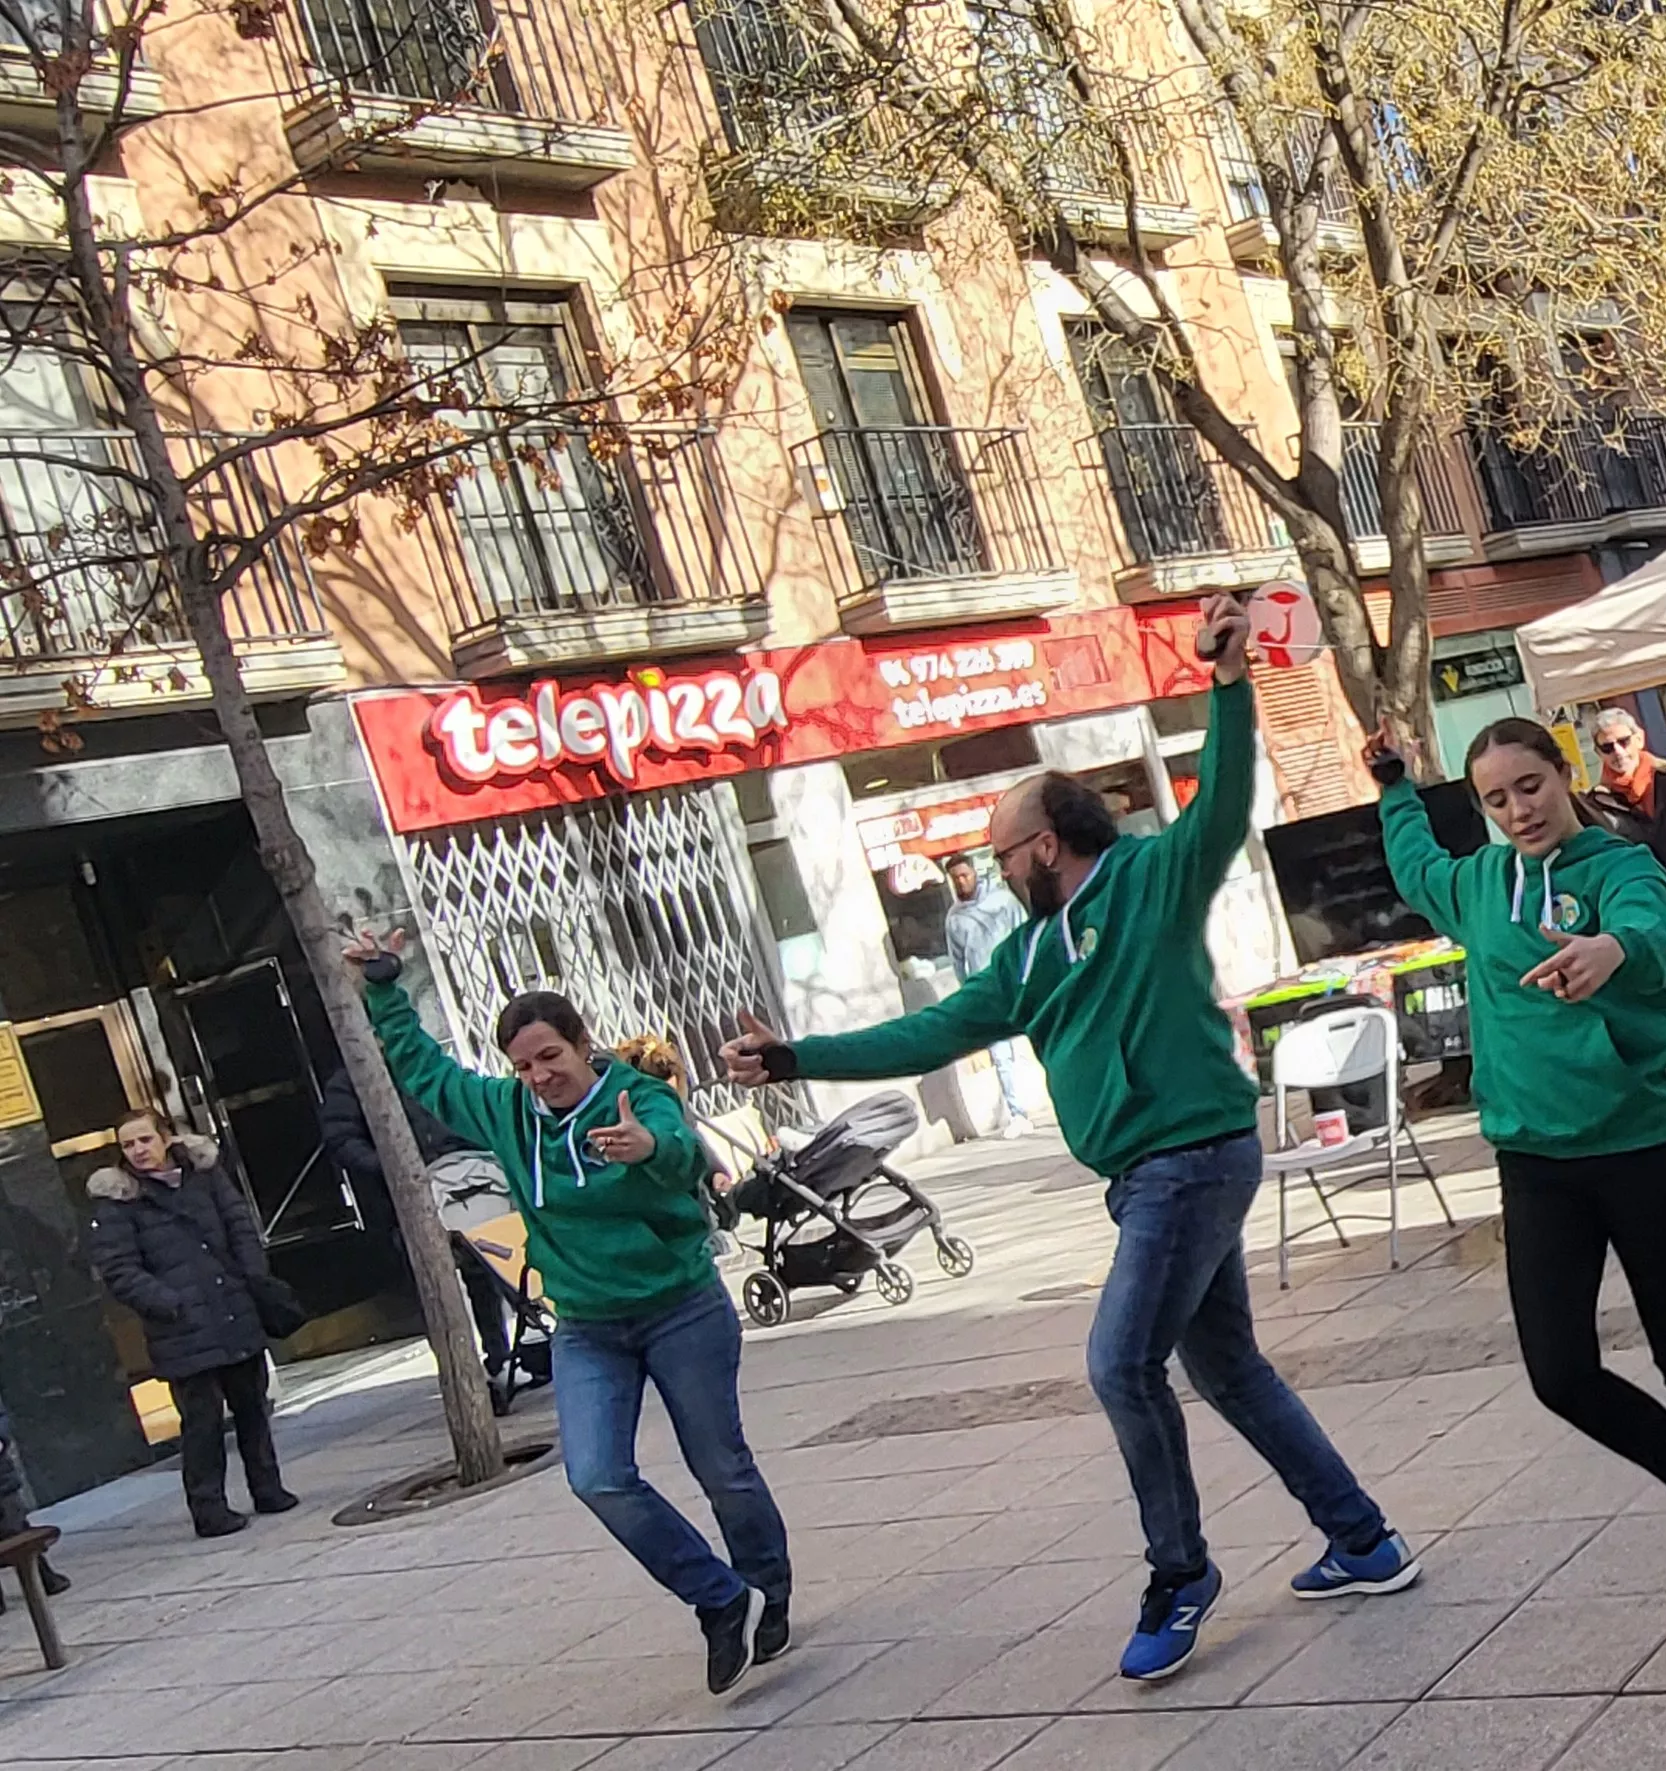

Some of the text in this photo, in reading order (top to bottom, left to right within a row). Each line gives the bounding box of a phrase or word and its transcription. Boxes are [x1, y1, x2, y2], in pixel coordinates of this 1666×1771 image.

[909, 653, 954, 683] 974
[441, 669, 788, 780] telepizza
[891, 680, 1047, 730] telepizza.es
